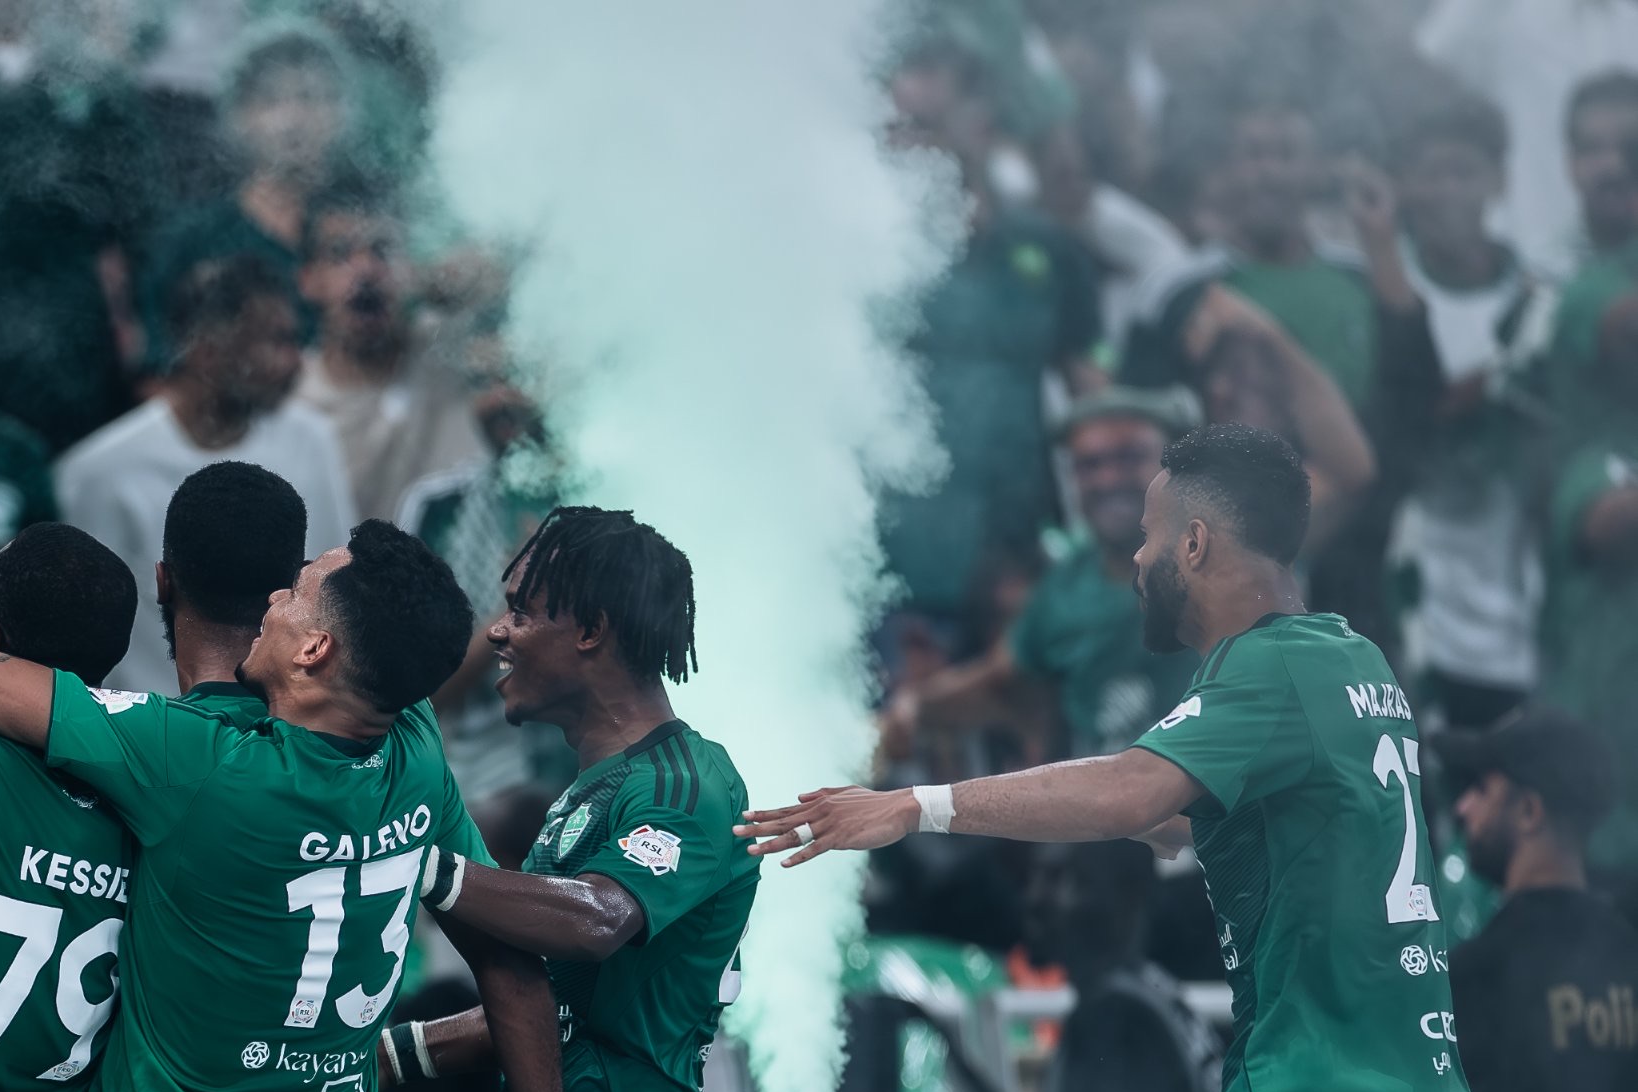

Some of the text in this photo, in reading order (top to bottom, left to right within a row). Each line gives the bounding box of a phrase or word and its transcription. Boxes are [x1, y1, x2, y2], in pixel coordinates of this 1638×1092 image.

[1345, 683, 1414, 721] MAJRAS
[640, 840, 663, 857] RSL
[283, 845, 425, 1029] 13
[1547, 983, 1638, 1050] Poli
